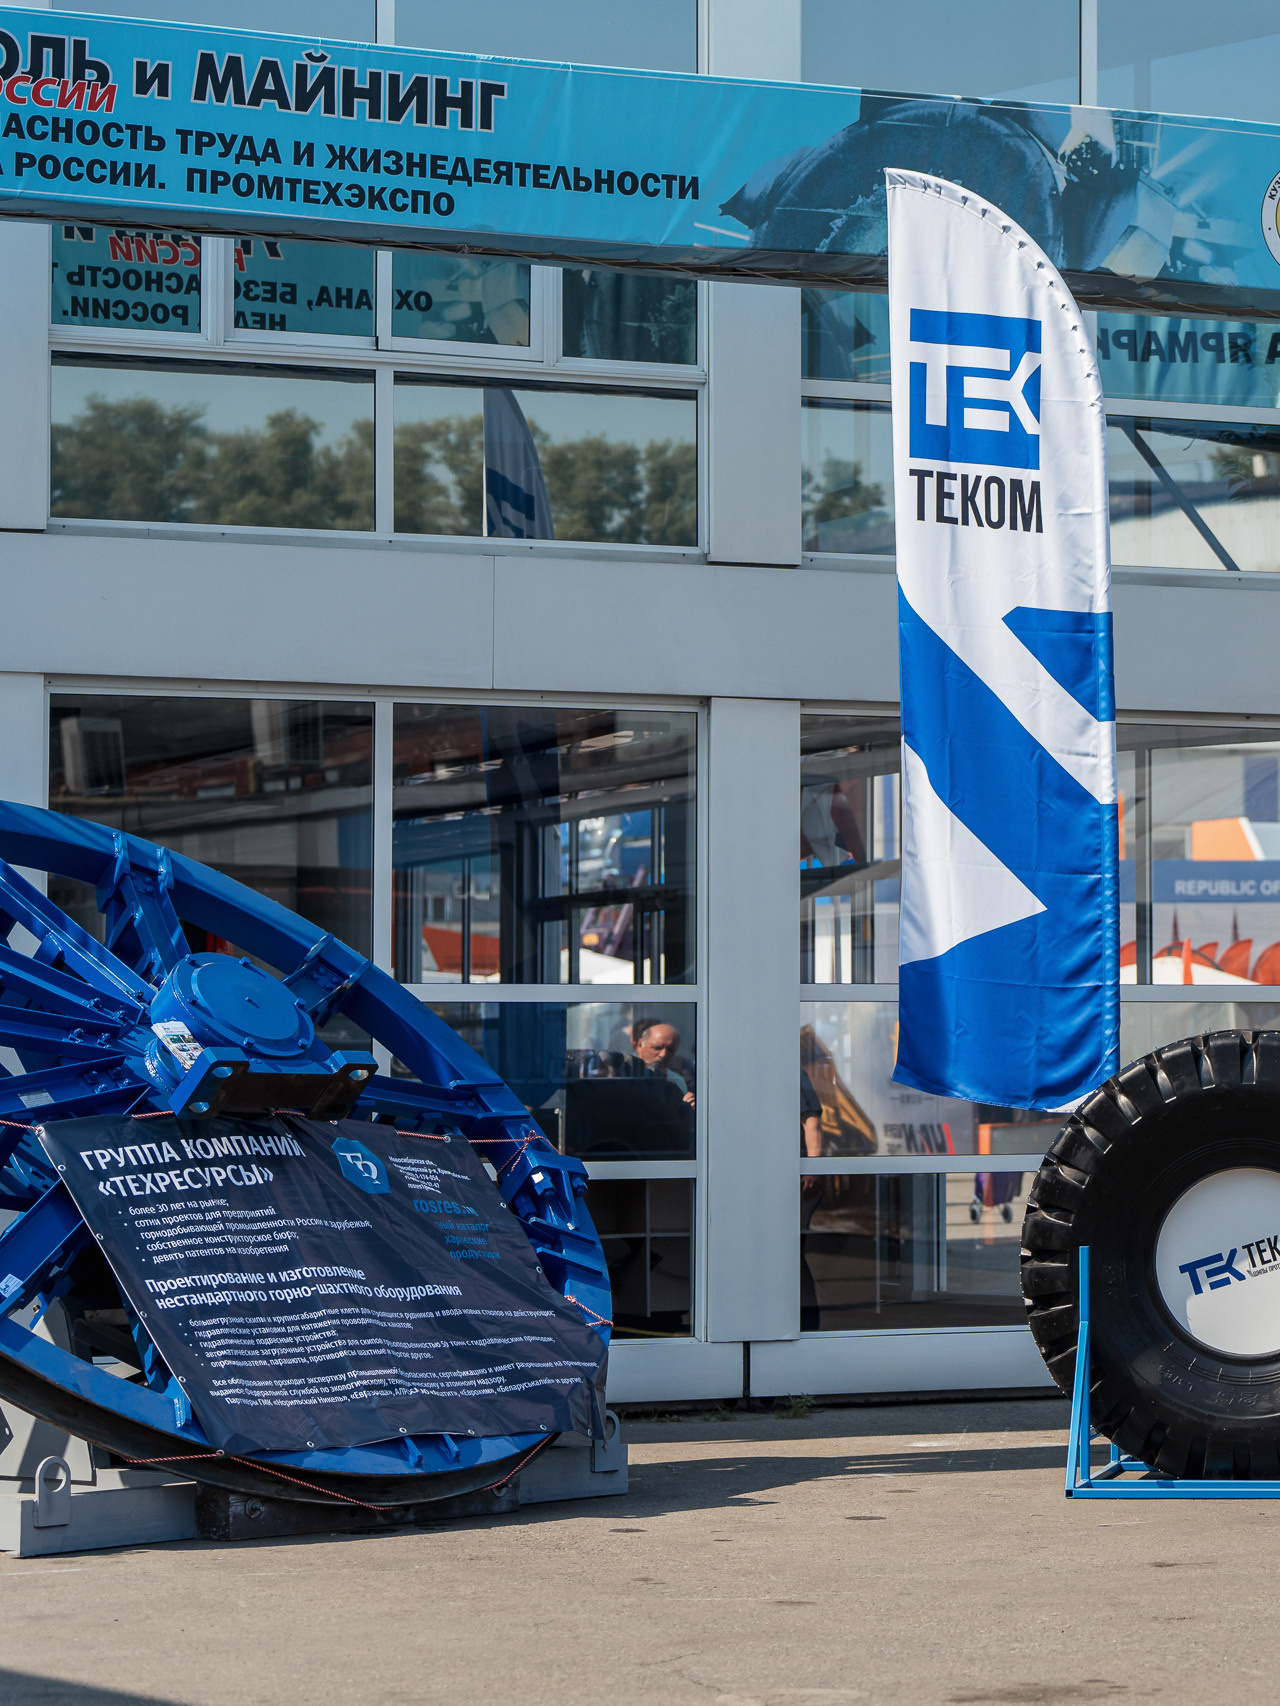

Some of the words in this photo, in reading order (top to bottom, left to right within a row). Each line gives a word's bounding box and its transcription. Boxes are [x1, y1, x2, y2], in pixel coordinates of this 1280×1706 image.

[0, 74, 119, 114] ССИИ
[133, 58, 172, 100] и
[190, 48, 507, 133] МАЙНИНГ
[2, 112, 167, 152] АСНОСТЬ
[175, 128, 282, 167] ТРУДА
[292, 140, 315, 168] И
[324, 142, 700, 201] ЖИЗНЕДЕЯТЕЛЬНОСТИ
[14, 151, 166, 190] РОССИИ.
[186, 167, 456, 217] ПРОМТЕХЭКСПО
[1174, 879, 1255, 896] REPUBLIC
[80, 1141, 181, 1171] ГРУППА
[180, 1132, 306, 1159] КОМПАНИЙ
[98, 1164, 274, 1197] «ТЕХРЕСУРСЫ»
[128, 1206, 156, 1216] более
[156, 1203, 169, 1213] 30
[170, 1201, 186, 1211] лет
[186, 1200, 198, 1209] на
[135, 1218, 161, 1228] сотни
[161, 1213, 204, 1226] проектов
[204, 1210, 222, 1221] для
[222, 1205, 277, 1220] предприятий
[140, 1221, 225, 1240] горнодобывающей
[225, 1219, 296, 1232] промышленности
[295, 1217, 324, 1227] России
[146, 1237, 204, 1252] собственное
[204, 1233, 273, 1245] конструкторское
[152, 1252, 185, 1265] девять
[185, 1247, 225, 1259] патентов
[225, 1246, 238, 1255] на
[237, 1244, 290, 1256] изобретения
[145, 1270, 266, 1295] Проектирование
[266, 1272, 278, 1284] и
[278, 1265, 367, 1284] изготовление
[155, 1288, 268, 1310] нестандартного
[268, 1281, 374, 1304] горно-шахтного
[373, 1283, 463, 1302] оборудования
[188, 1316, 245, 1327] большегрузные
[245, 1316, 267, 1325] скипы
[272, 1308, 340, 1324] крупногабаритные
[339, 1307, 360, 1316] клети
[404, 1311, 435, 1320] рудников
[441, 1308, 463, 1317] ввода
[194, 1328, 251, 1338] гидравлические
[251, 1326, 287, 1336] установки
[286, 1325, 301, 1333] для
[300, 1319, 341, 1331] натяжения
[199, 1338, 256, 1349] гидравлические
[255, 1336, 294, 1345] подвесные
[205, 1349, 261, 1358] автоматические
[260, 1346, 305, 1356] загрузочные
[305, 1339, 347, 1353] устройства
[347, 1339, 360, 1347] для
[360, 1338, 383, 1346] скипов
[270, 1356, 310, 1367] парашюты,
[310, 1349, 357, 1364] противовесы
[357, 1348, 386, 1356] шахтные
[212, 1379, 228, 1387] Все
[273, 1378, 306, 1388] проходит
[306, 1373, 347, 1385] экспертизу
[347, 1367, 399, 1379] промышленной
[439, 1367, 488, 1379] сертификацию
[494, 1362, 516, 1373] имеет
[319, 1386, 330, 1394] по
